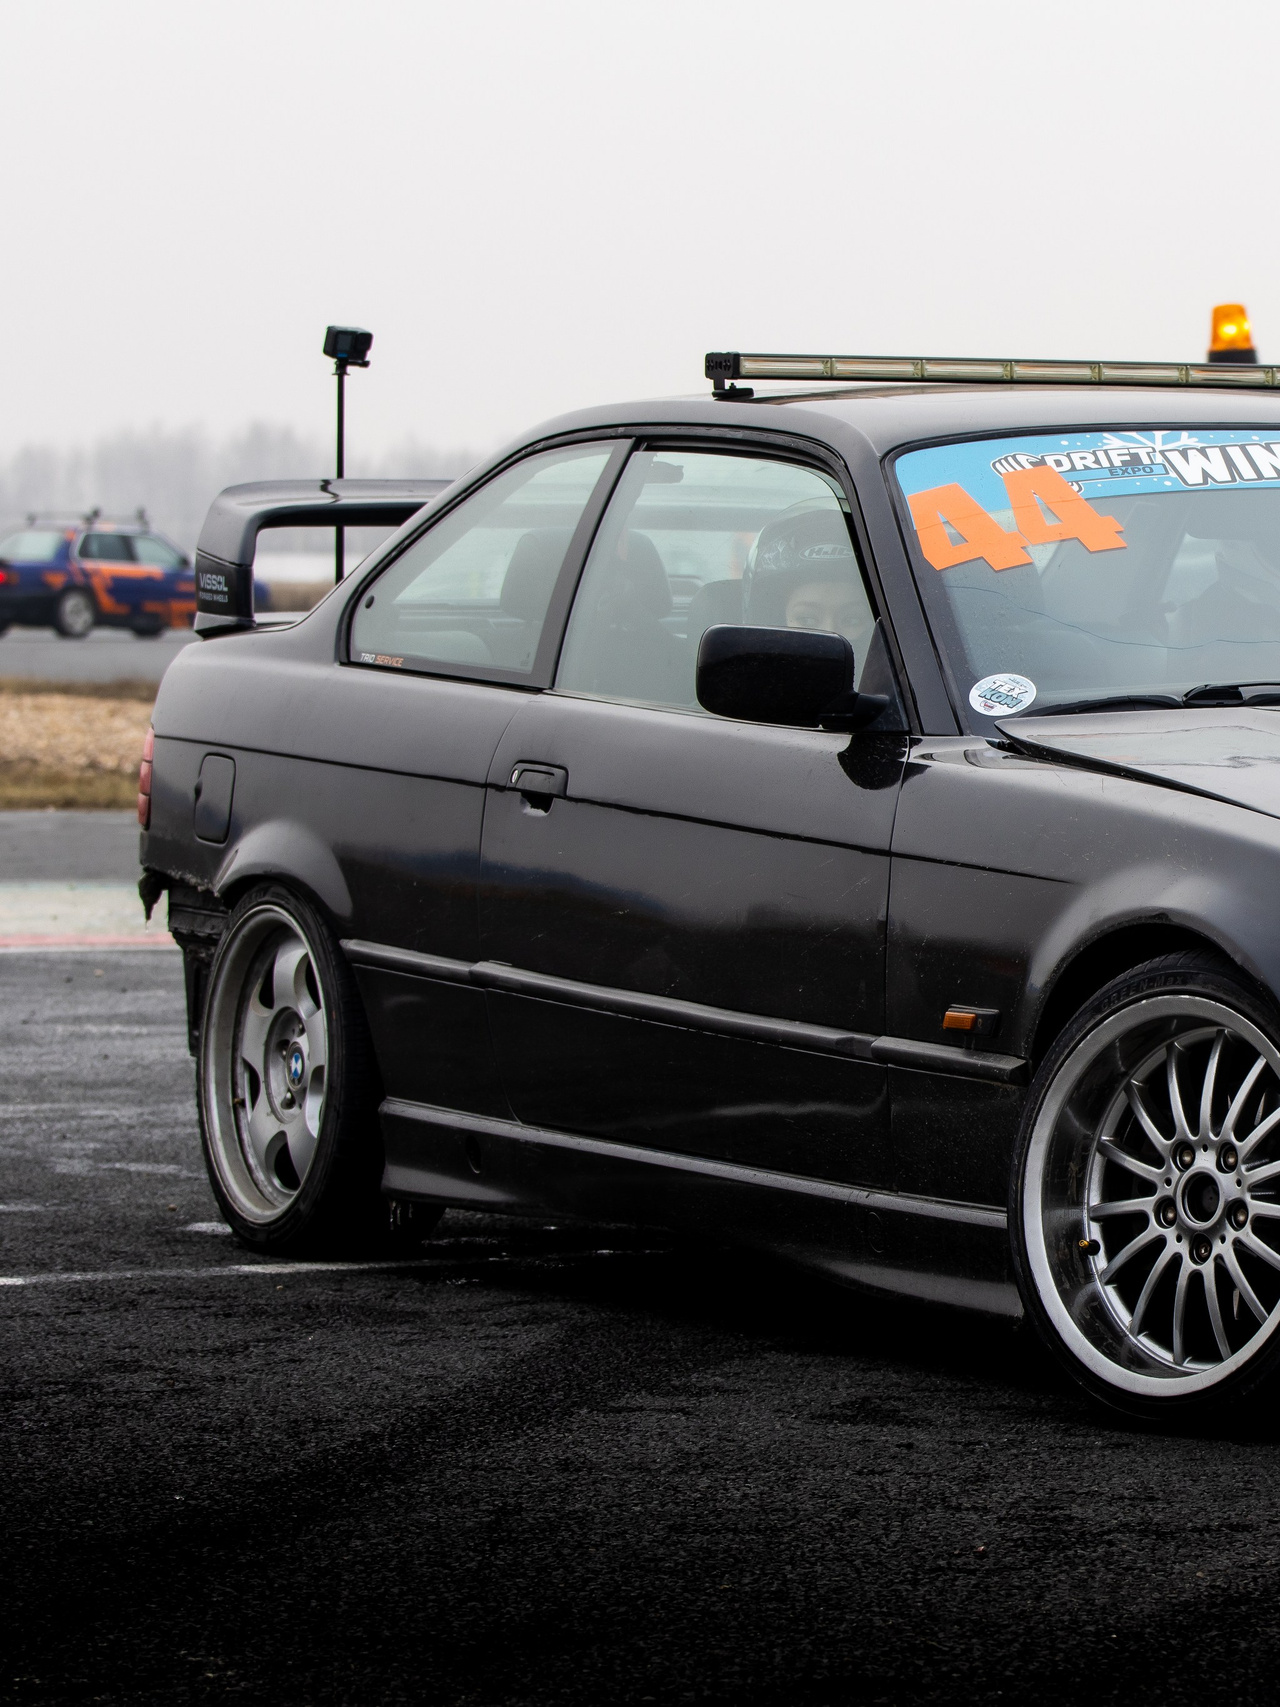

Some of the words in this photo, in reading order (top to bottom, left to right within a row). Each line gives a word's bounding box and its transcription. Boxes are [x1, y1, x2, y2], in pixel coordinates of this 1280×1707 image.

[1046, 448, 1157, 474] DRIFT
[1107, 466, 1155, 477] EXPO
[907, 465, 1128, 571] 44
[360, 652, 376, 663] TRIO
[376, 655, 405, 667] SERVICE
